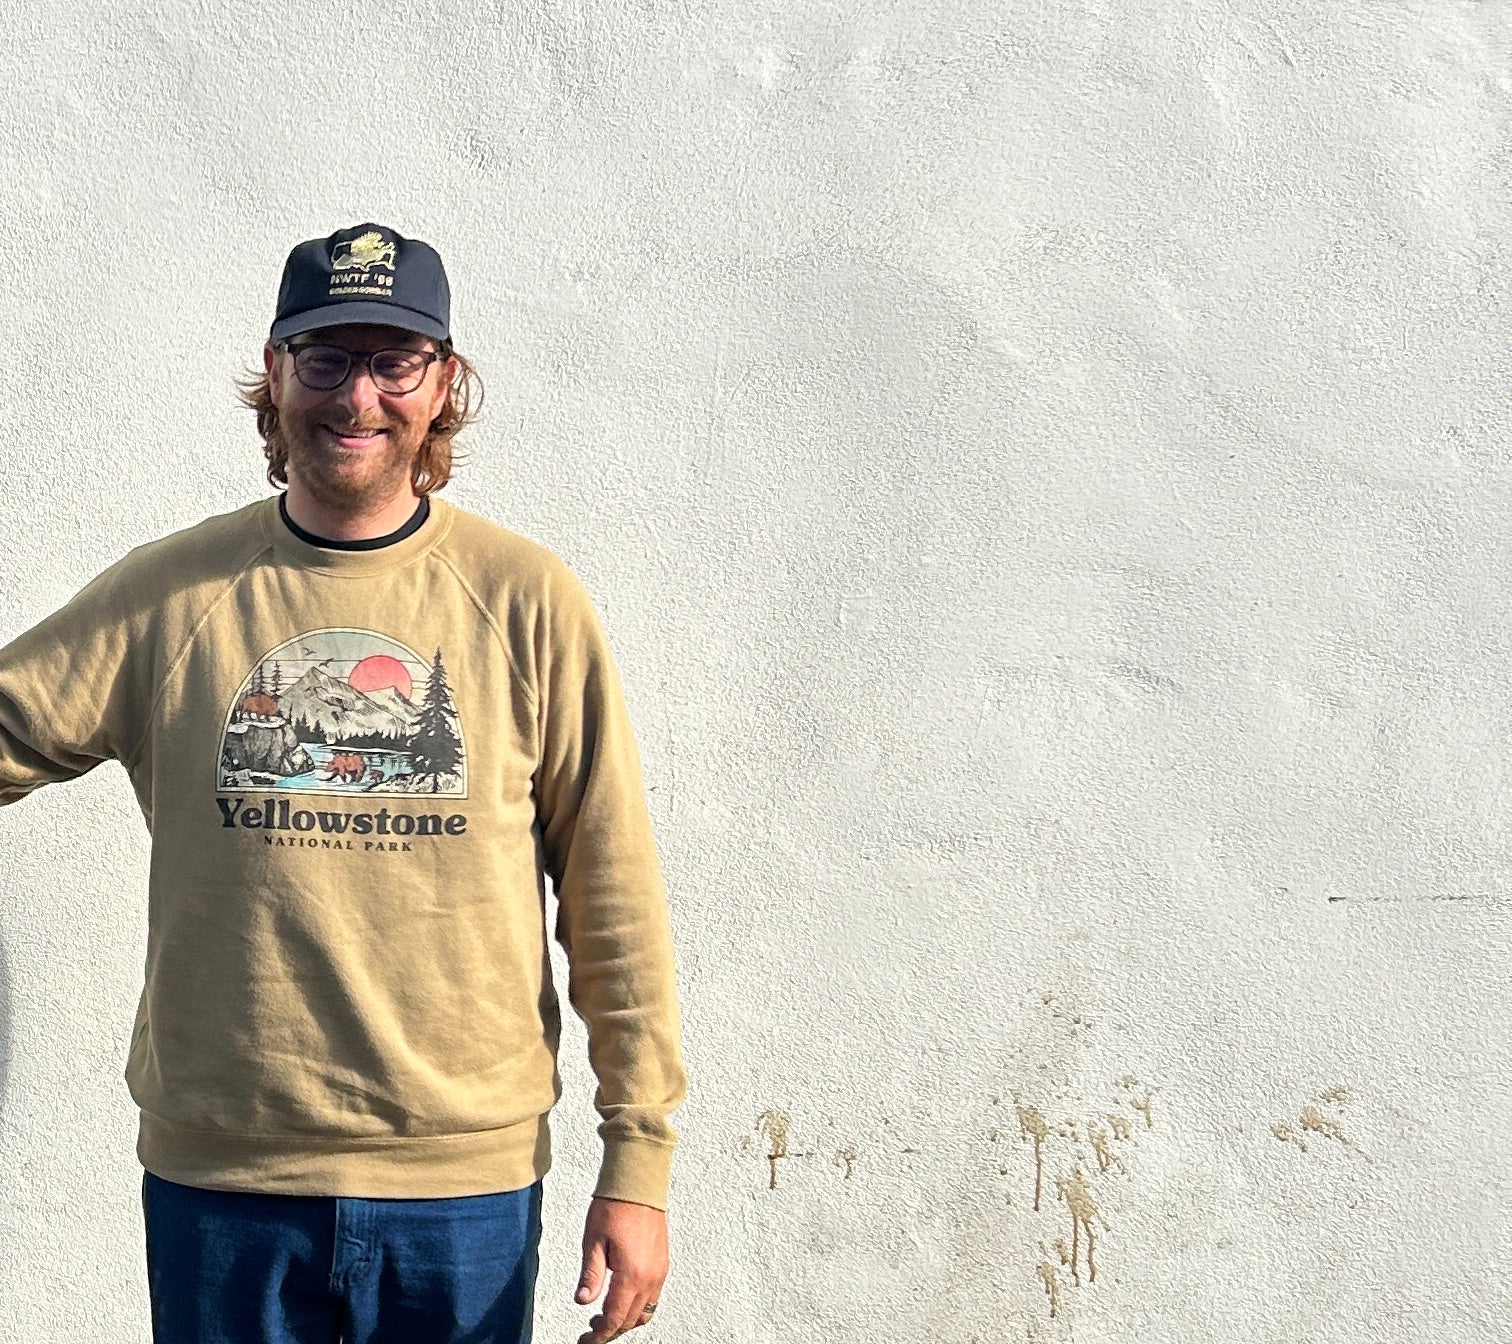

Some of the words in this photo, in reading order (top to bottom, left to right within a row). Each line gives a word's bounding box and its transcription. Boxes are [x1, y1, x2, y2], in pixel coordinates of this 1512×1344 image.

[216, 798, 468, 836] Yellowstone
[264, 835, 354, 850] NATIONAL
[364, 841, 413, 852] PARK
